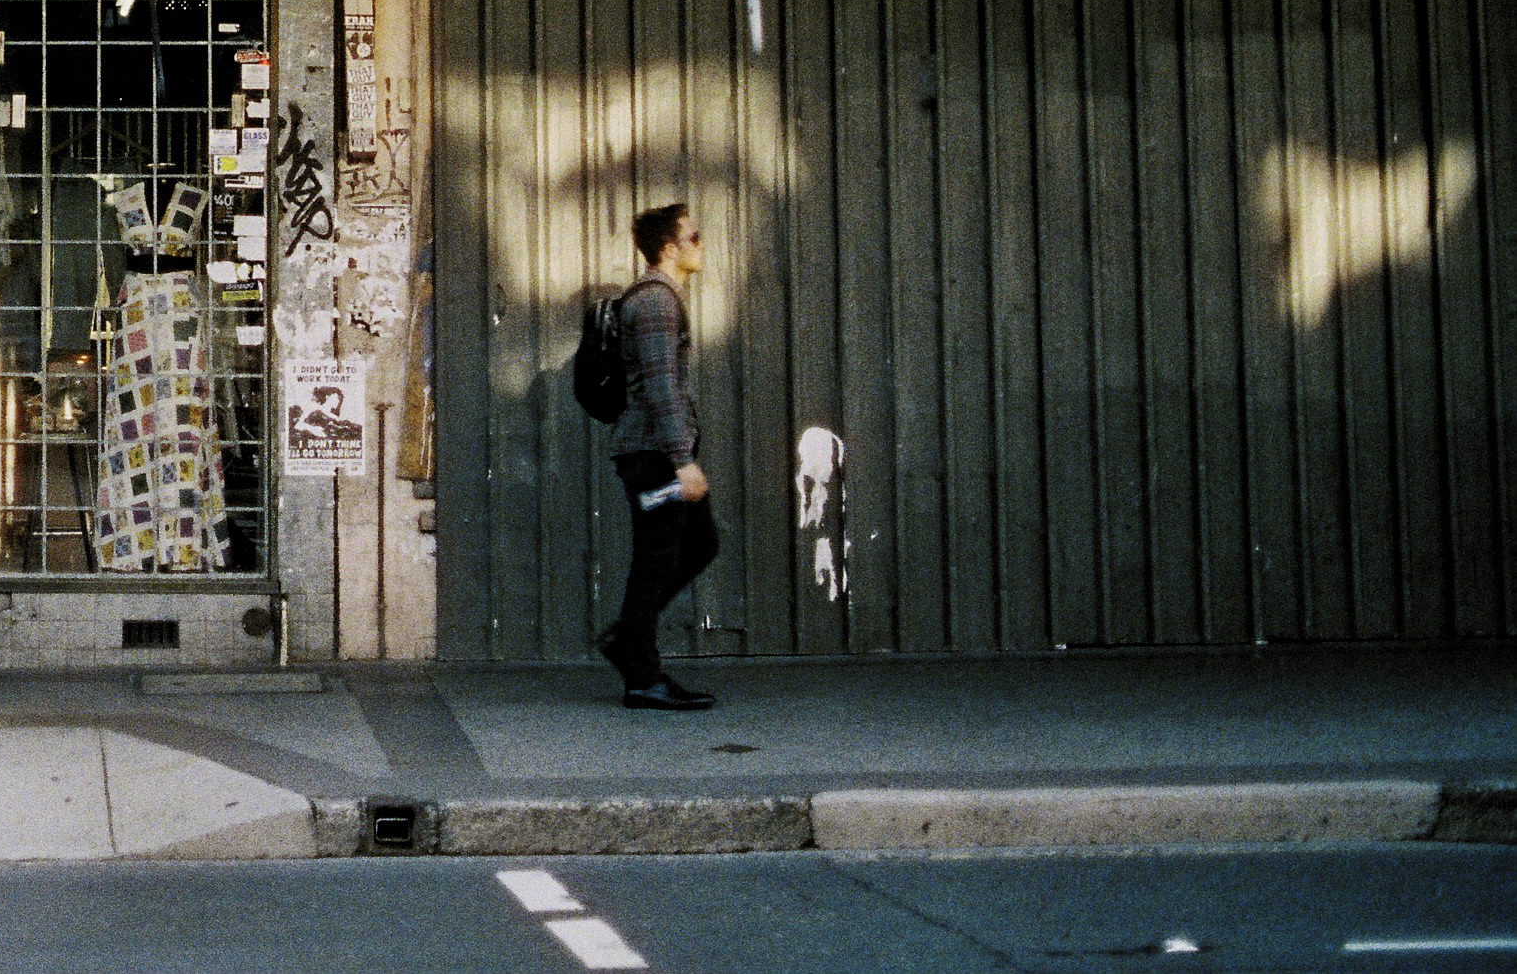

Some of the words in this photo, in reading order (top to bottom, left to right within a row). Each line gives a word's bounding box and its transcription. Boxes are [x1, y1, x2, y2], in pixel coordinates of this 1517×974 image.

[348, 66, 372, 78] THAT
[352, 73, 372, 84] GUY
[349, 86, 374, 94] THAT
[352, 93, 372, 102] GUY
[349, 103, 374, 111] THAT
[352, 110, 372, 119] GUY
[244, 131, 268, 140] GLASS
[346, 366, 357, 374] TO
[297, 375, 322, 383] WORK
[335, 439, 362, 449] THINK
[302, 449, 315, 458] GO
[316, 449, 362, 458] TOMORROW
